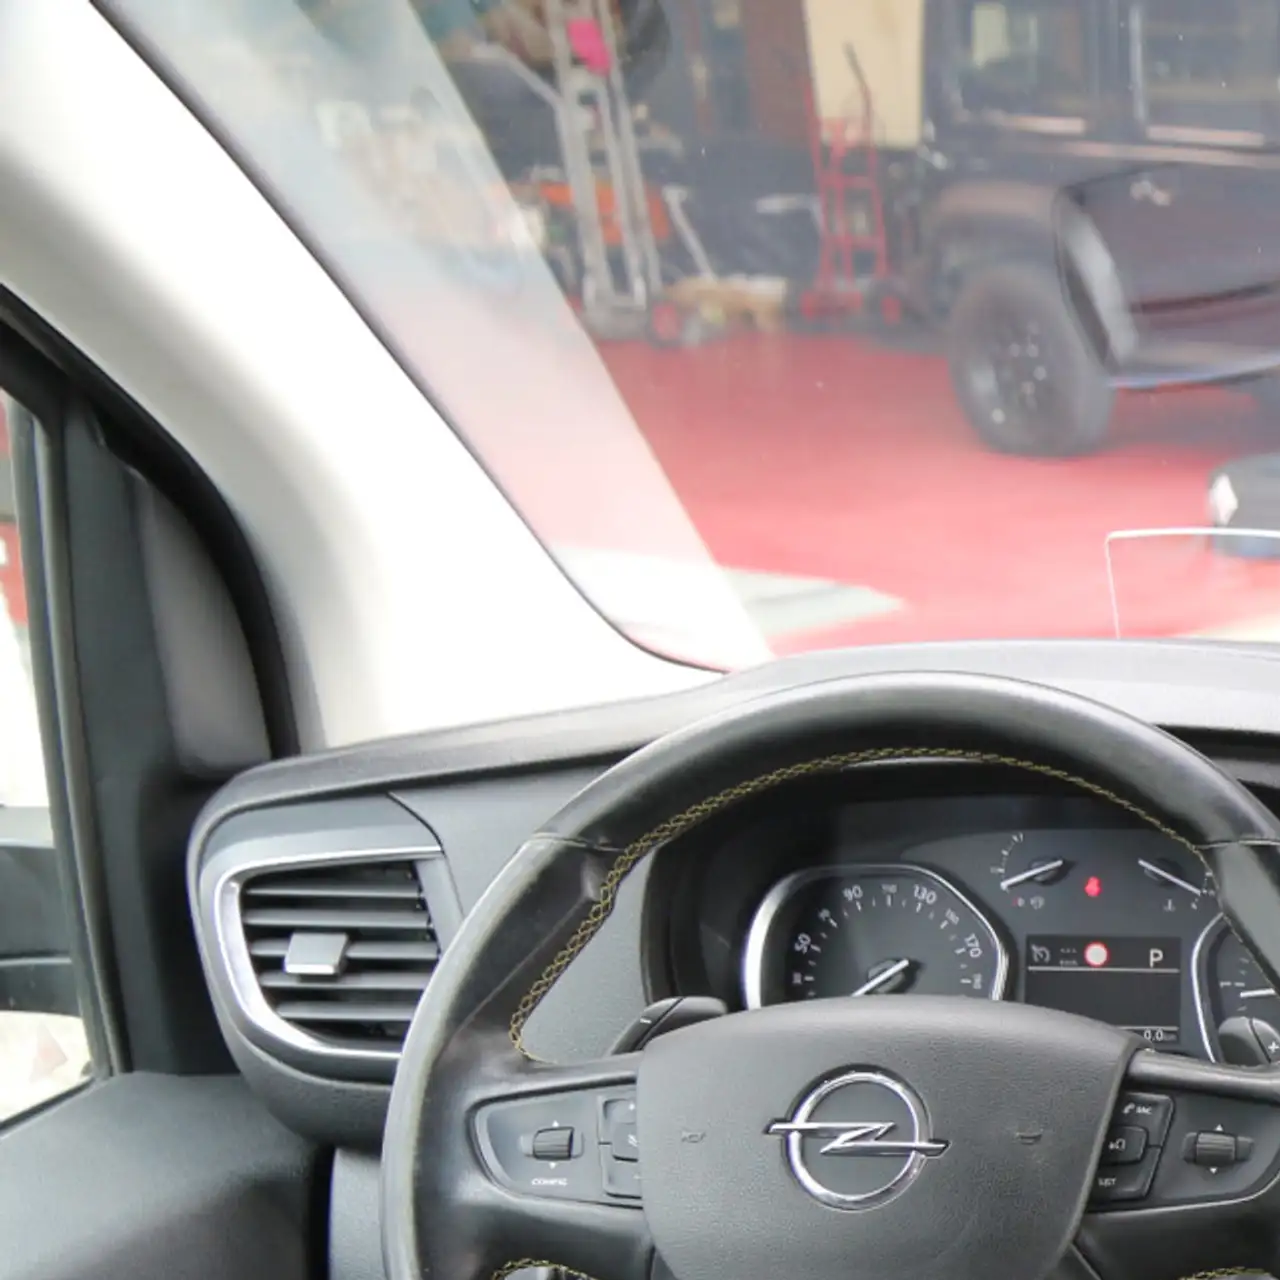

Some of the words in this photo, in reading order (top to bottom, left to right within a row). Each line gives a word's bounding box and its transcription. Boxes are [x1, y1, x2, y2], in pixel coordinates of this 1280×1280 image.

[842, 884, 863, 901] 90
[913, 884, 937, 904] 130
[794, 932, 812, 955] 50
[963, 932, 983, 959] 170
[1149, 948, 1164, 969] P
[1143, 1029, 1164, 1042] 0.0
